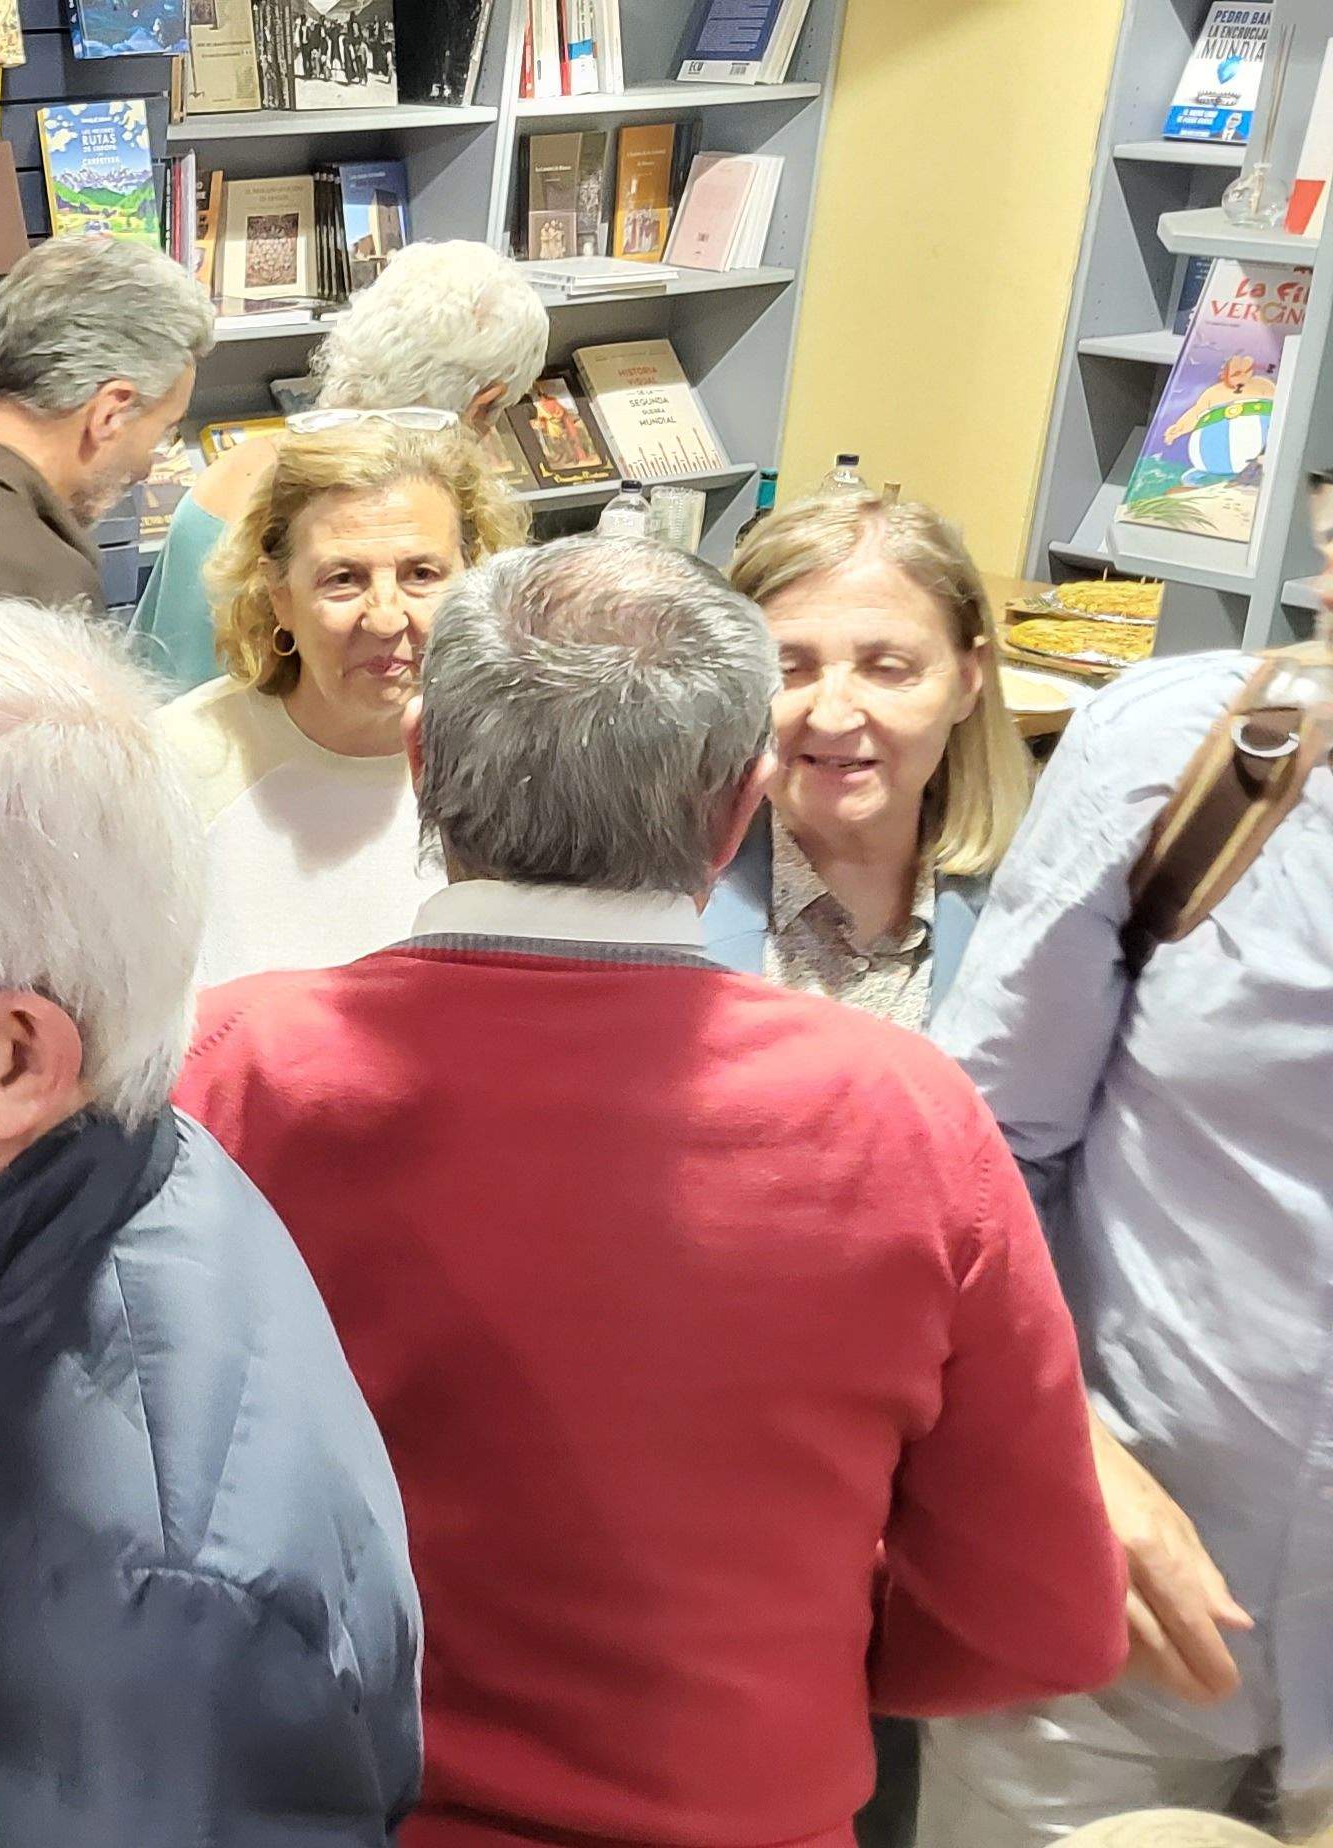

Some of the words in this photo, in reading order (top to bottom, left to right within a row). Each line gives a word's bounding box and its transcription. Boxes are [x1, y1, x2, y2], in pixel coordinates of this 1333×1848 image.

[1213, 10, 1250, 24] PEDRO
[1208, 25, 1219, 38] LA
[82, 134, 117, 146] RUTAS
[1235, 279, 1266, 298] La
[617, 366, 658, 377] HISTORIA
[629, 397, 669, 407] SEGUNDA
[639, 416, 677, 427] MUNDIAL
